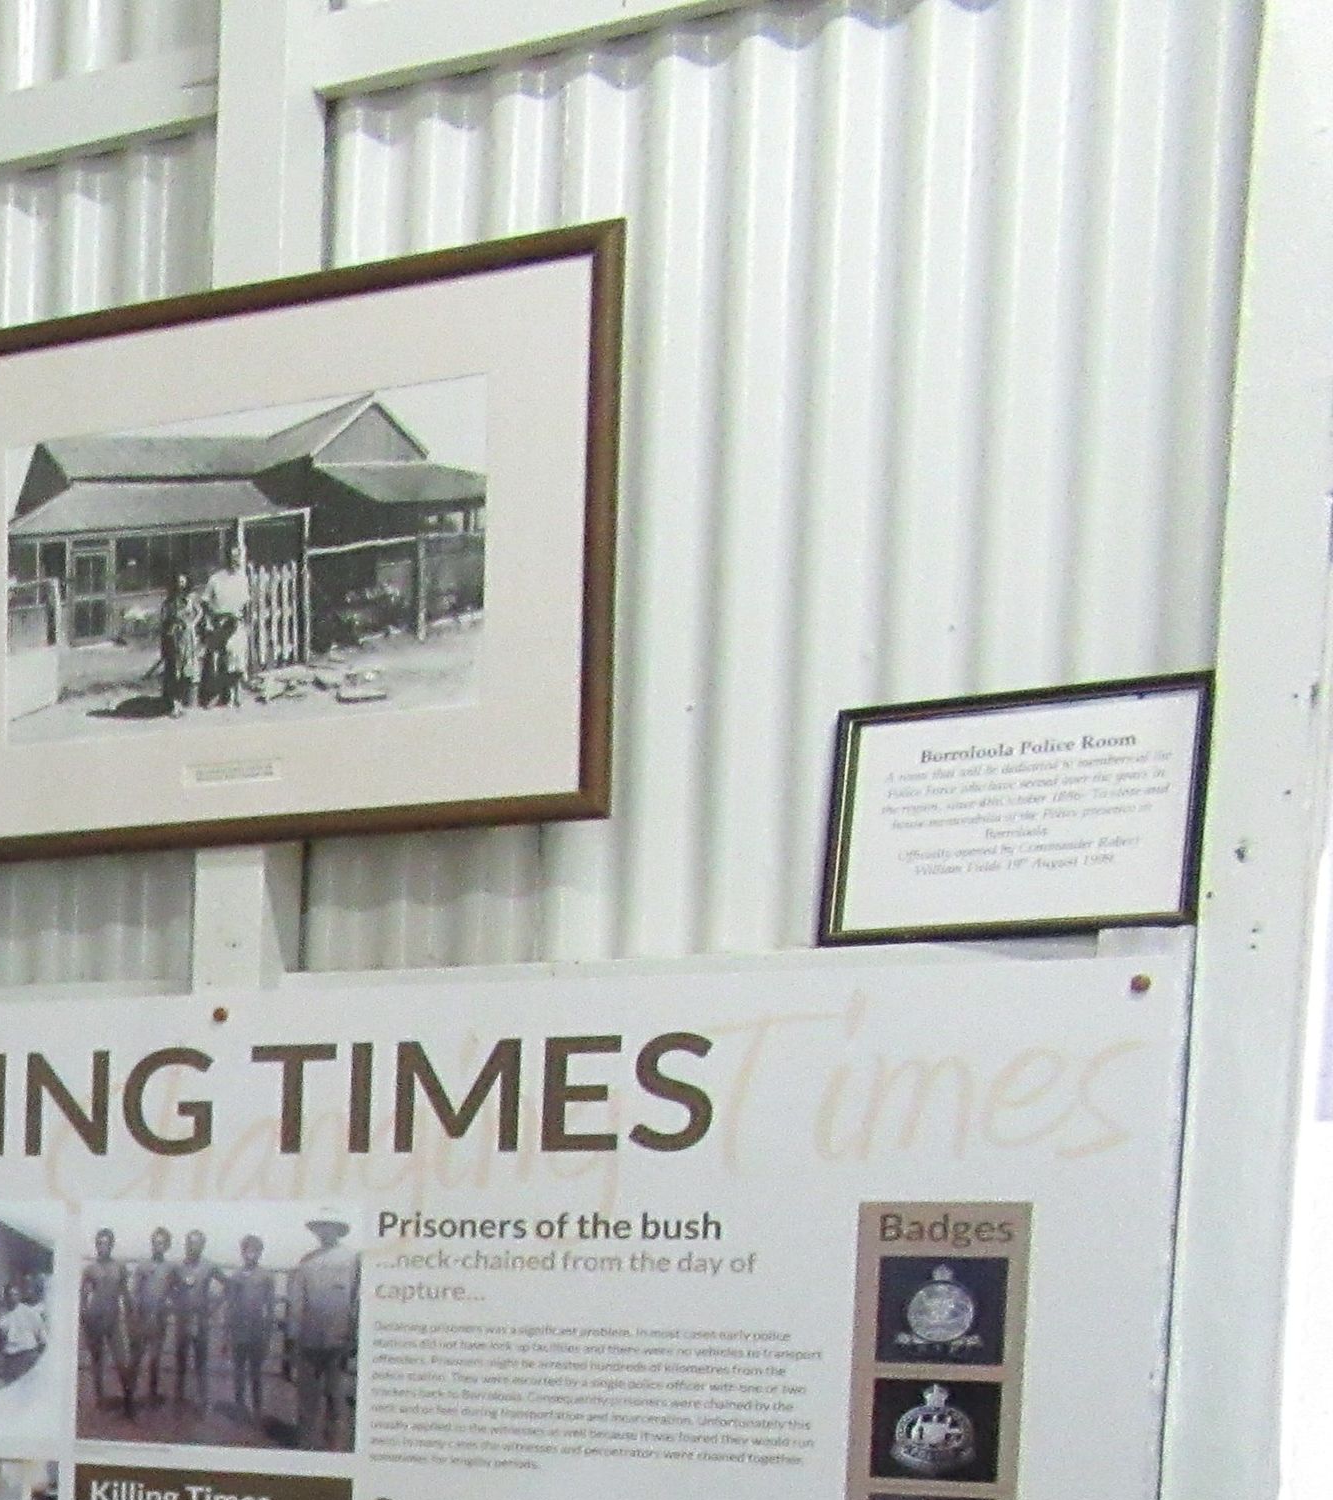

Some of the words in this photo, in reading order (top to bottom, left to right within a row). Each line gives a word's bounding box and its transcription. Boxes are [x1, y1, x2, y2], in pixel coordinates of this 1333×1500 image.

[919, 741, 1014, 764] Borroloola
[1019, 736, 1075, 756] Police
[1081, 731, 1137, 750] Room
[251, 1032, 713, 1153] TIMES
[377, 1210, 527, 1240] Prisoners
[534, 1211, 569, 1240] of
[576, 1211, 632, 1241] the
[640, 1212, 723, 1242] bush
[878, 1213, 1015, 1249] Badges
[562, 1251, 622, 1273] from
[629, 1253, 672, 1275] the
[677, 1254, 723, 1279] day
[729, 1253, 757, 1275] of
